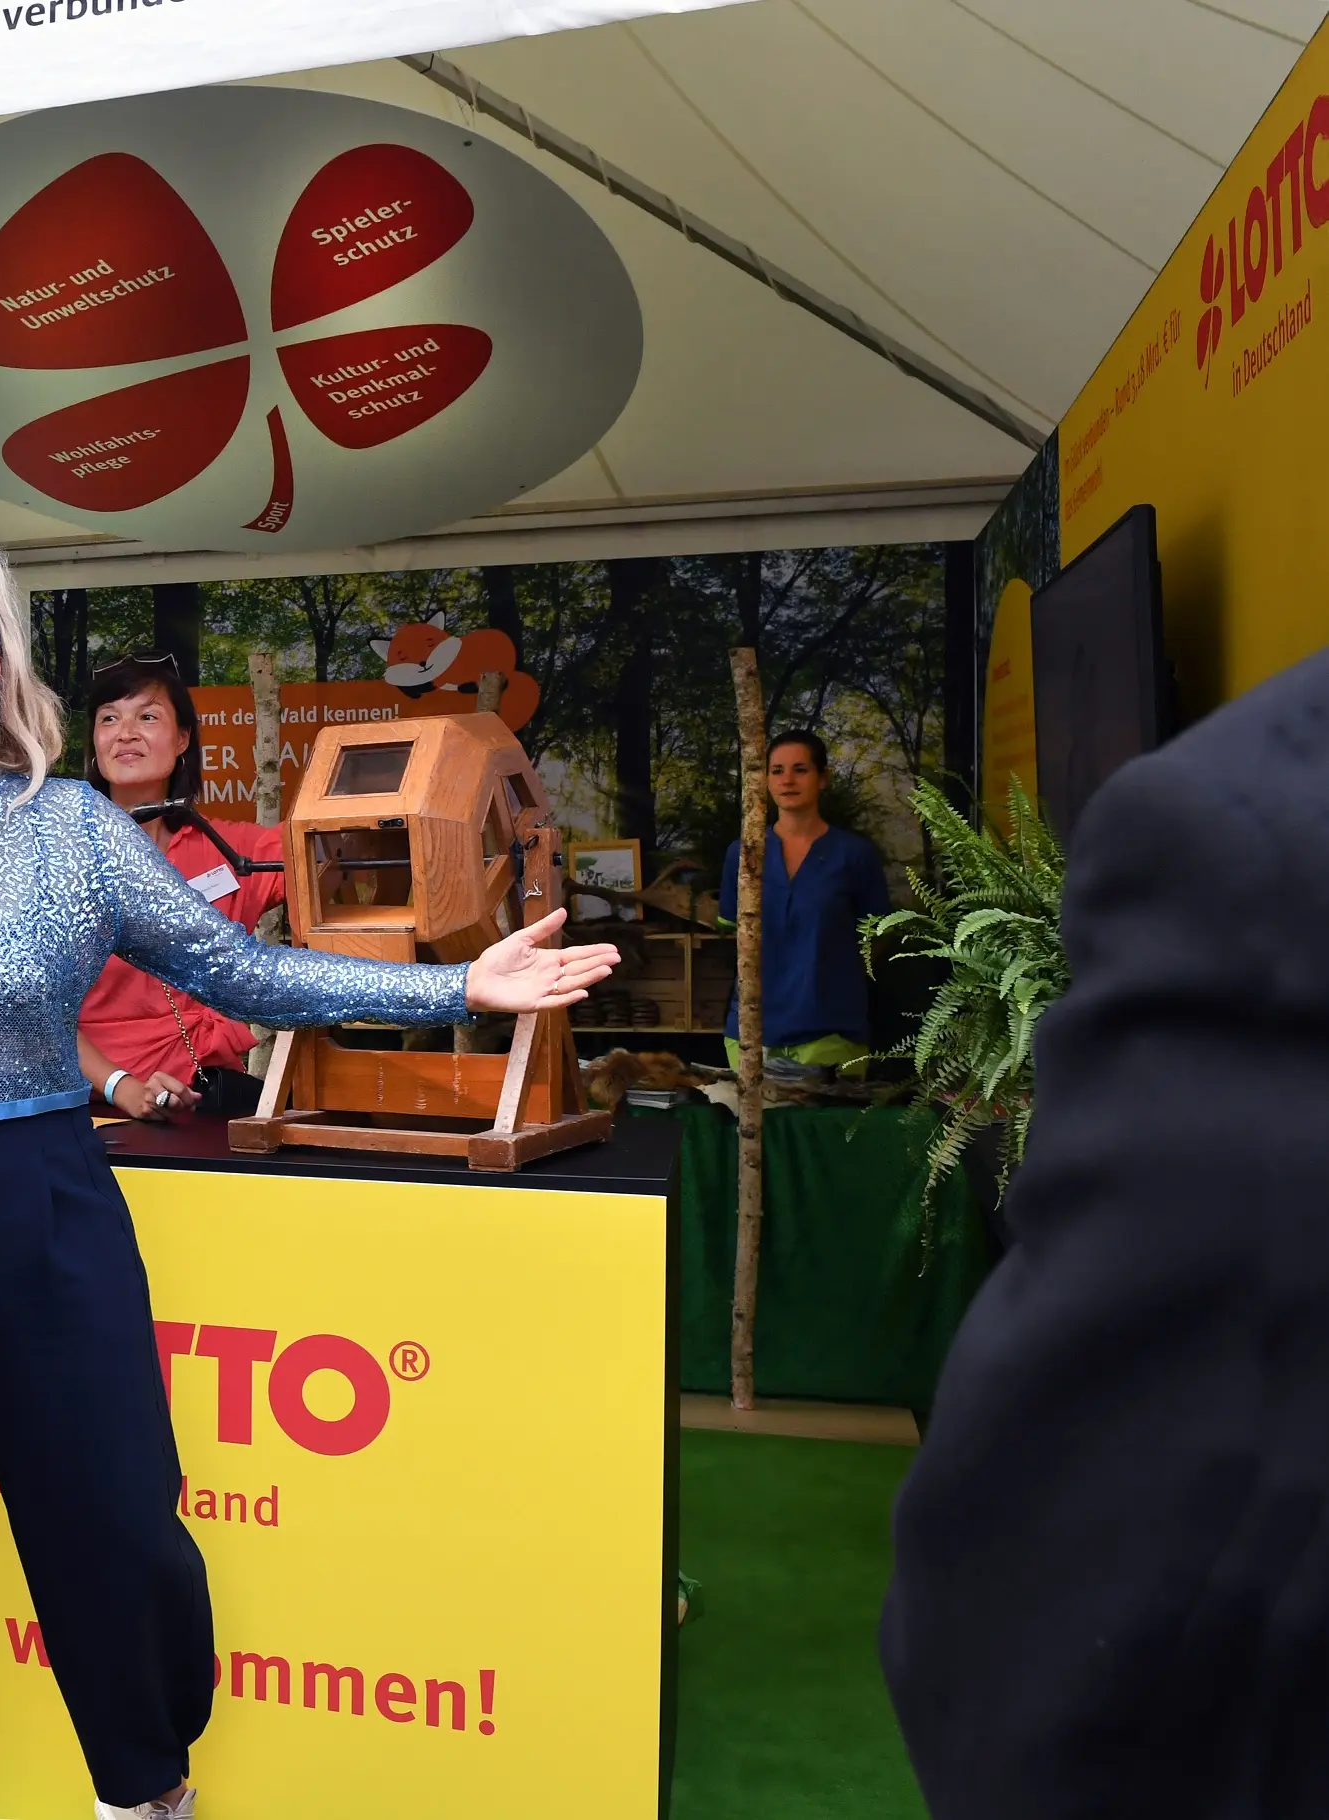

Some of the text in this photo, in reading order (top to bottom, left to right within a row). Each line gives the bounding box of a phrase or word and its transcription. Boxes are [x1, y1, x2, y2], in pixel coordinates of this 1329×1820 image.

[311, 197, 412, 246] Spieler-
[333, 223, 418, 266] schutz
[0, 258, 114, 312] Natur- und
[21, 264, 175, 330] Umweltschutz
[1232, 279, 1311, 398] in Deutschland
[311, 337, 441, 389] Kultur- und
[328, 364, 437, 404] Denkmal-
[347, 387, 423, 421] schutz
[49, 426, 161, 466] Wohlfahrts-
[71, 453, 131, 478] pflege
[258, 501, 289, 530] Sport
[232, 708, 254, 725] de
[323, 704, 399, 722] kennen!
[202, 745, 239, 771] ER
